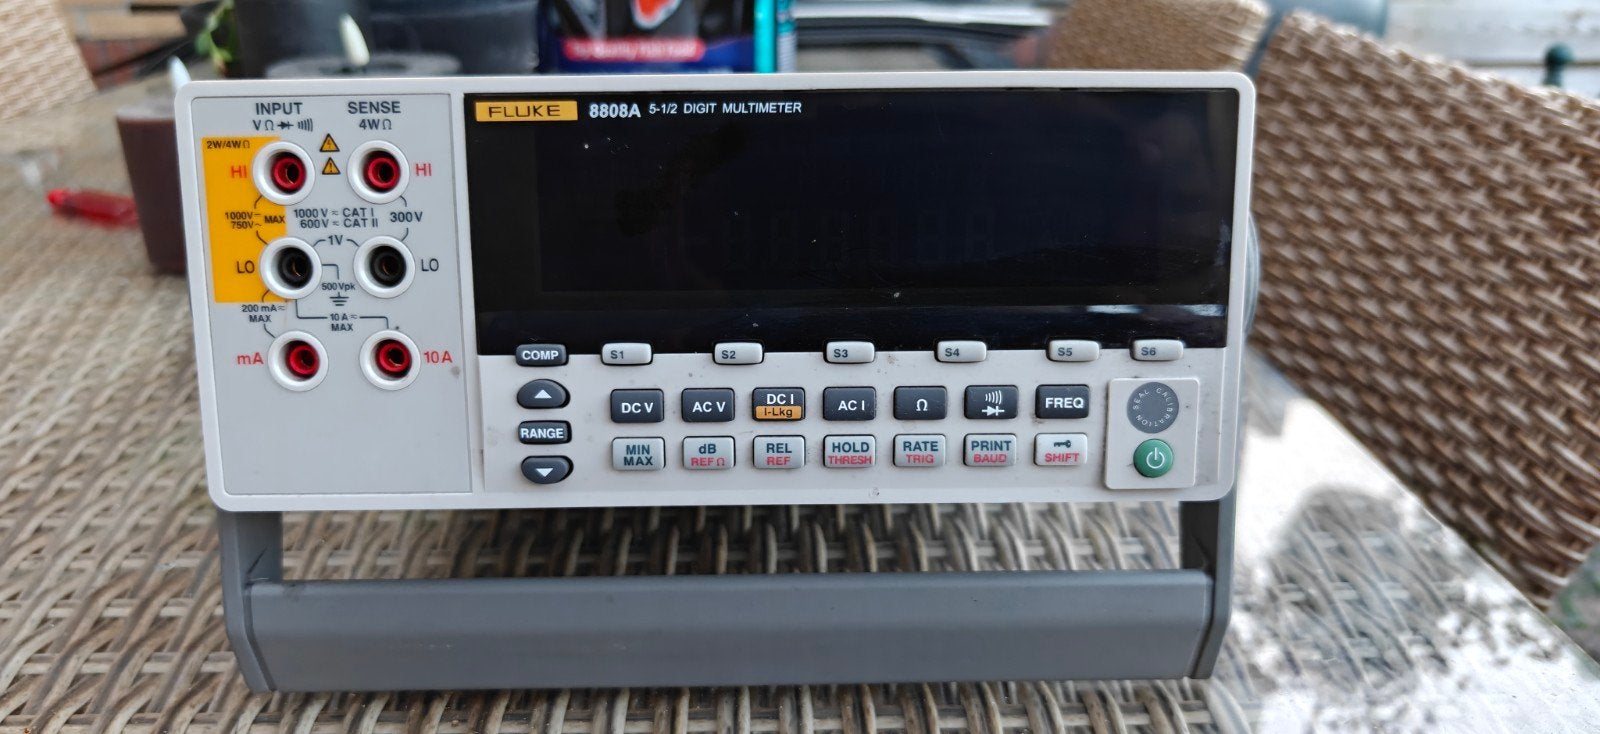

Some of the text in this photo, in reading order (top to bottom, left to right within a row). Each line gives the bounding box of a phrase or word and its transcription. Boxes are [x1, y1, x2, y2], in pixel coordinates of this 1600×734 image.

[256, 102, 303, 115] INPUT
[348, 101, 401, 114] SENSE
[488, 105, 561, 118] FLUKE
[589, 102, 802, 118] 8808A 5-1/2 DIGIT MULTIMETER
[253, 120, 262, 130] V
[231, 165, 247, 178] HI
[416, 163, 432, 176] HI
[342, 208, 367, 218] CAT
[264, 216, 286, 224] MAX
[344, 218, 368, 228] CAT
[372, 218, 378, 228] II
[328, 236, 343, 246] 1V
[236, 260, 254, 274] LO
[421, 258, 440, 272] LO
[249, 314, 272, 322] MAX
[331, 323, 354, 331] MAX
[522, 350, 559, 361] COMP
[610, 350, 624, 360] S1
[722, 350, 736, 360] S2
[834, 348, 848, 358] S3
[944, 348, 960, 358] S4
[1057, 347, 1073, 358] S5
[1141, 346, 1156, 357] S6
[237, 352, 264, 365] mA
[766, 394, 788, 404] DC
[1046, 397, 1084, 410] FREQ
[621, 402, 654, 414] DC V
[692, 401, 726, 412] AC V
[838, 400, 860, 411] AC
[916, 400, 928, 412] Ω
[1132, 388, 1173, 427] CALIBRATION SEAL
[764, 407, 793, 418] I-Lkg
[520, 428, 564, 438] RANGE
[626, 444, 650, 455] MIN
[698, 442, 717, 454] dB
[766, 442, 792, 454] REL
[832, 442, 870, 452] HOLD
[902, 441, 939, 452] RATE
[971, 440, 1012, 451] PRINT
[623, 455, 654, 466] MAX
[766, 456, 790, 466] REF
[828, 454, 872, 465] THRESH
[905, 454, 934, 464] TRIG
[973, 452, 1007, 464] BAUD
[1044, 452, 1080, 462] SHIFT
